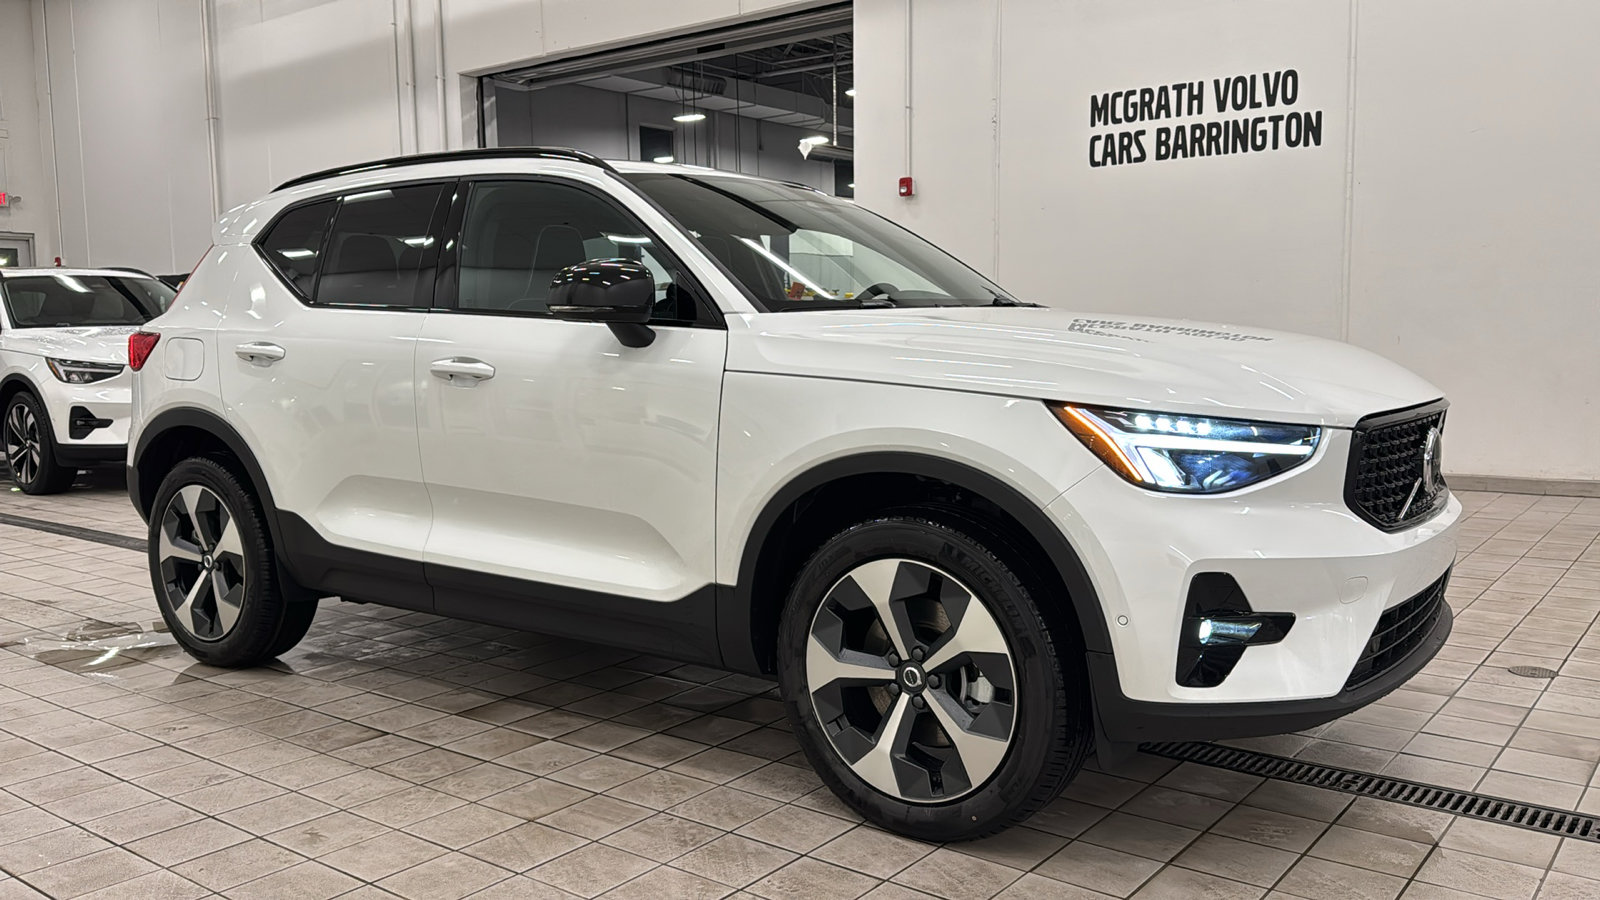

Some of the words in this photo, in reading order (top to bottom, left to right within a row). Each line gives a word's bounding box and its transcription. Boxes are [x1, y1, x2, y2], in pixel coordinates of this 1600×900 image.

[1090, 80, 1204, 128] MCGRATH
[1213, 69, 1299, 113] VOLVO
[1089, 129, 1147, 168] CARS
[1155, 110, 1323, 161] BARRINGTON
